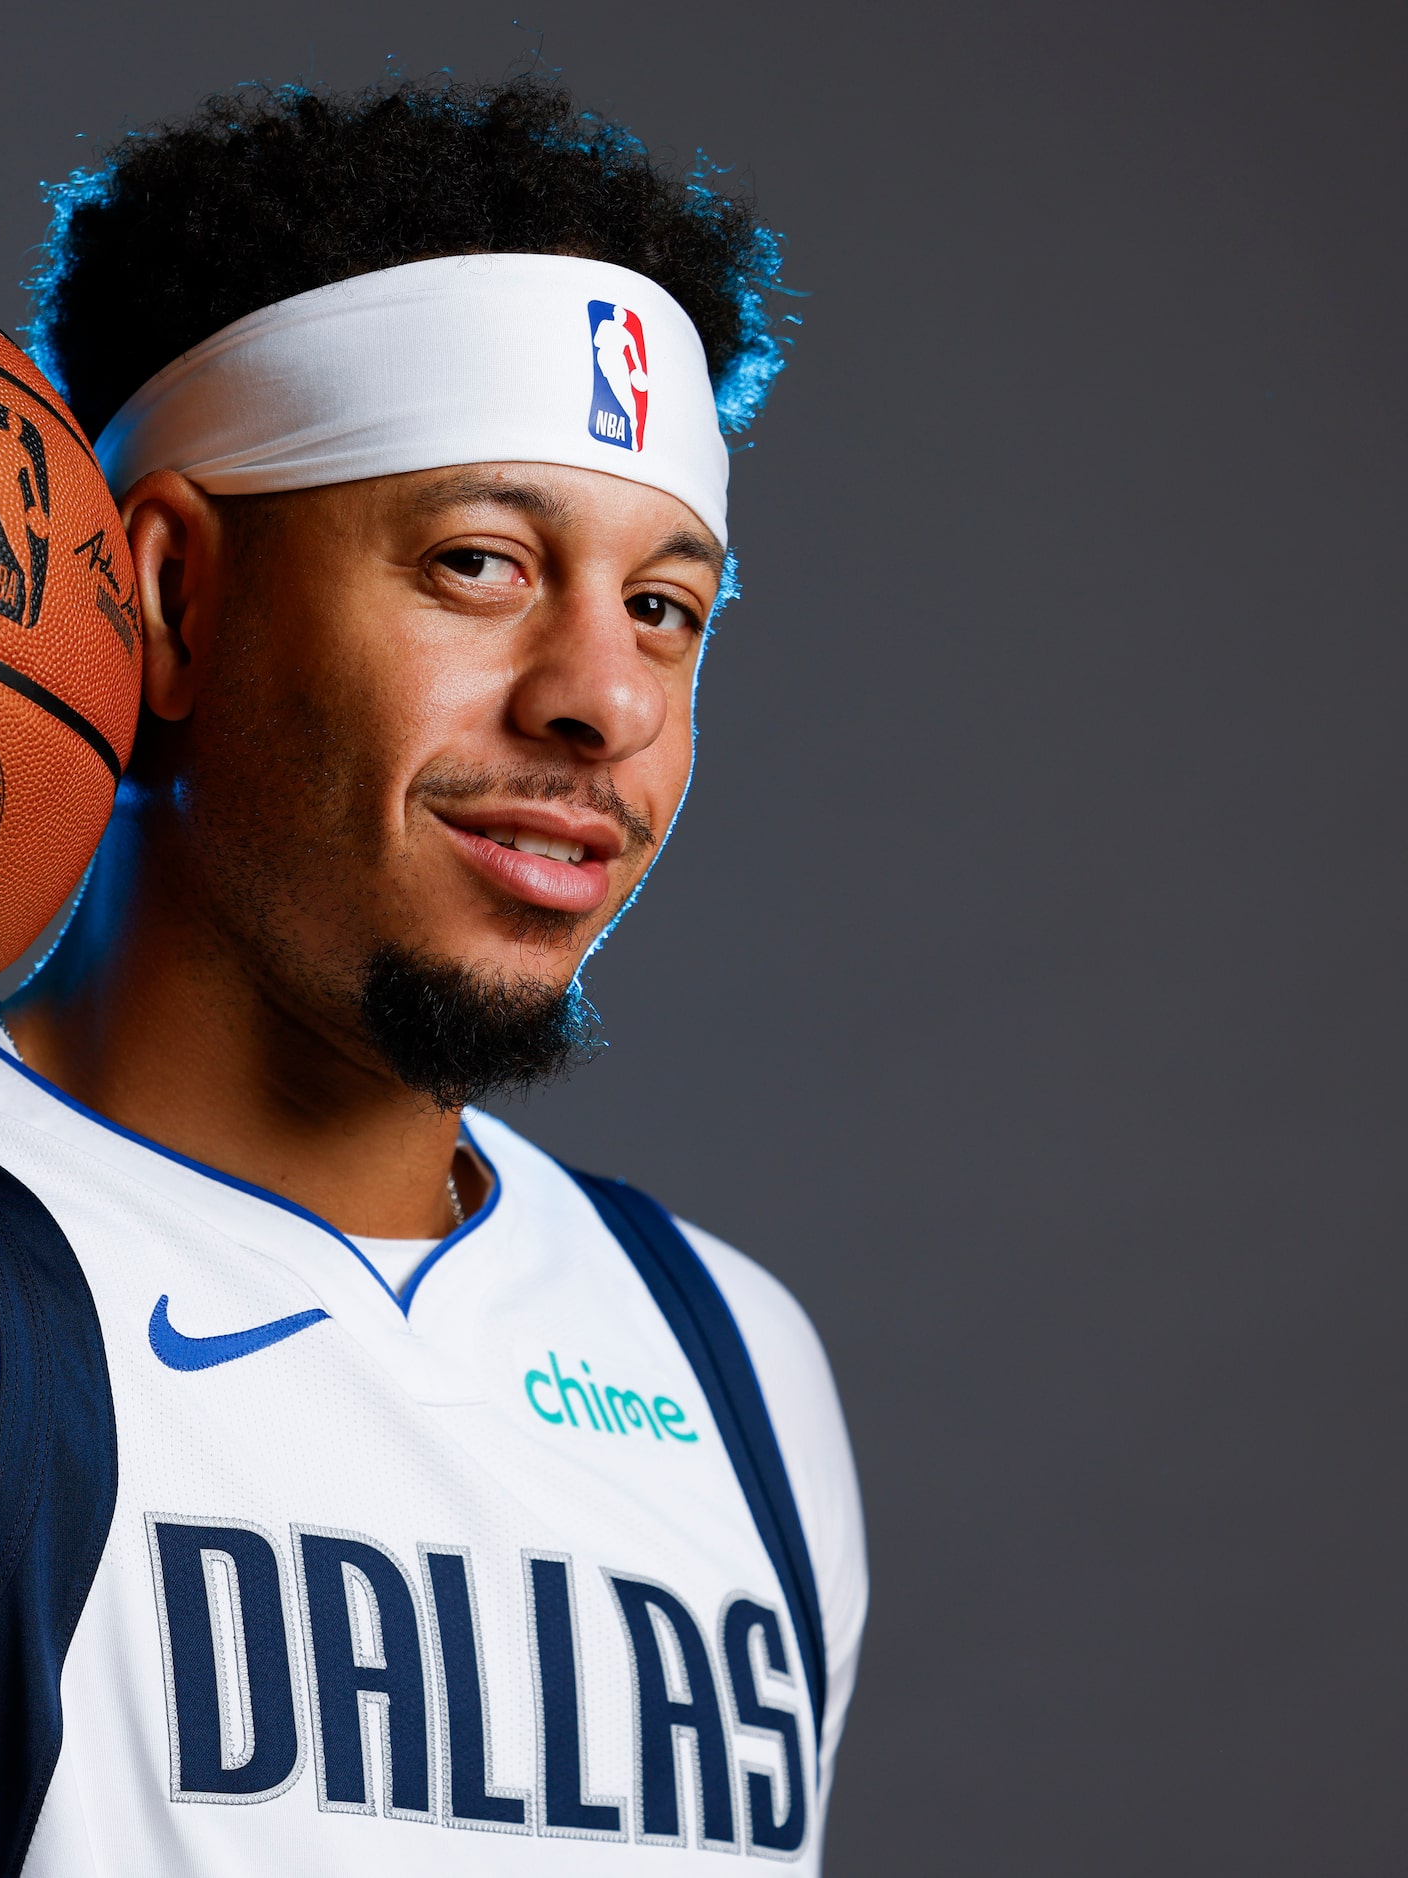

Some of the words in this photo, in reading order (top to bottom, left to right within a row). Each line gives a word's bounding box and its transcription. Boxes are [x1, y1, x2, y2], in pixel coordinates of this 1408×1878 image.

[595, 410, 626, 442] NBA
[524, 1350, 699, 1443] chime
[143, 1511, 809, 1863] DALLAS
